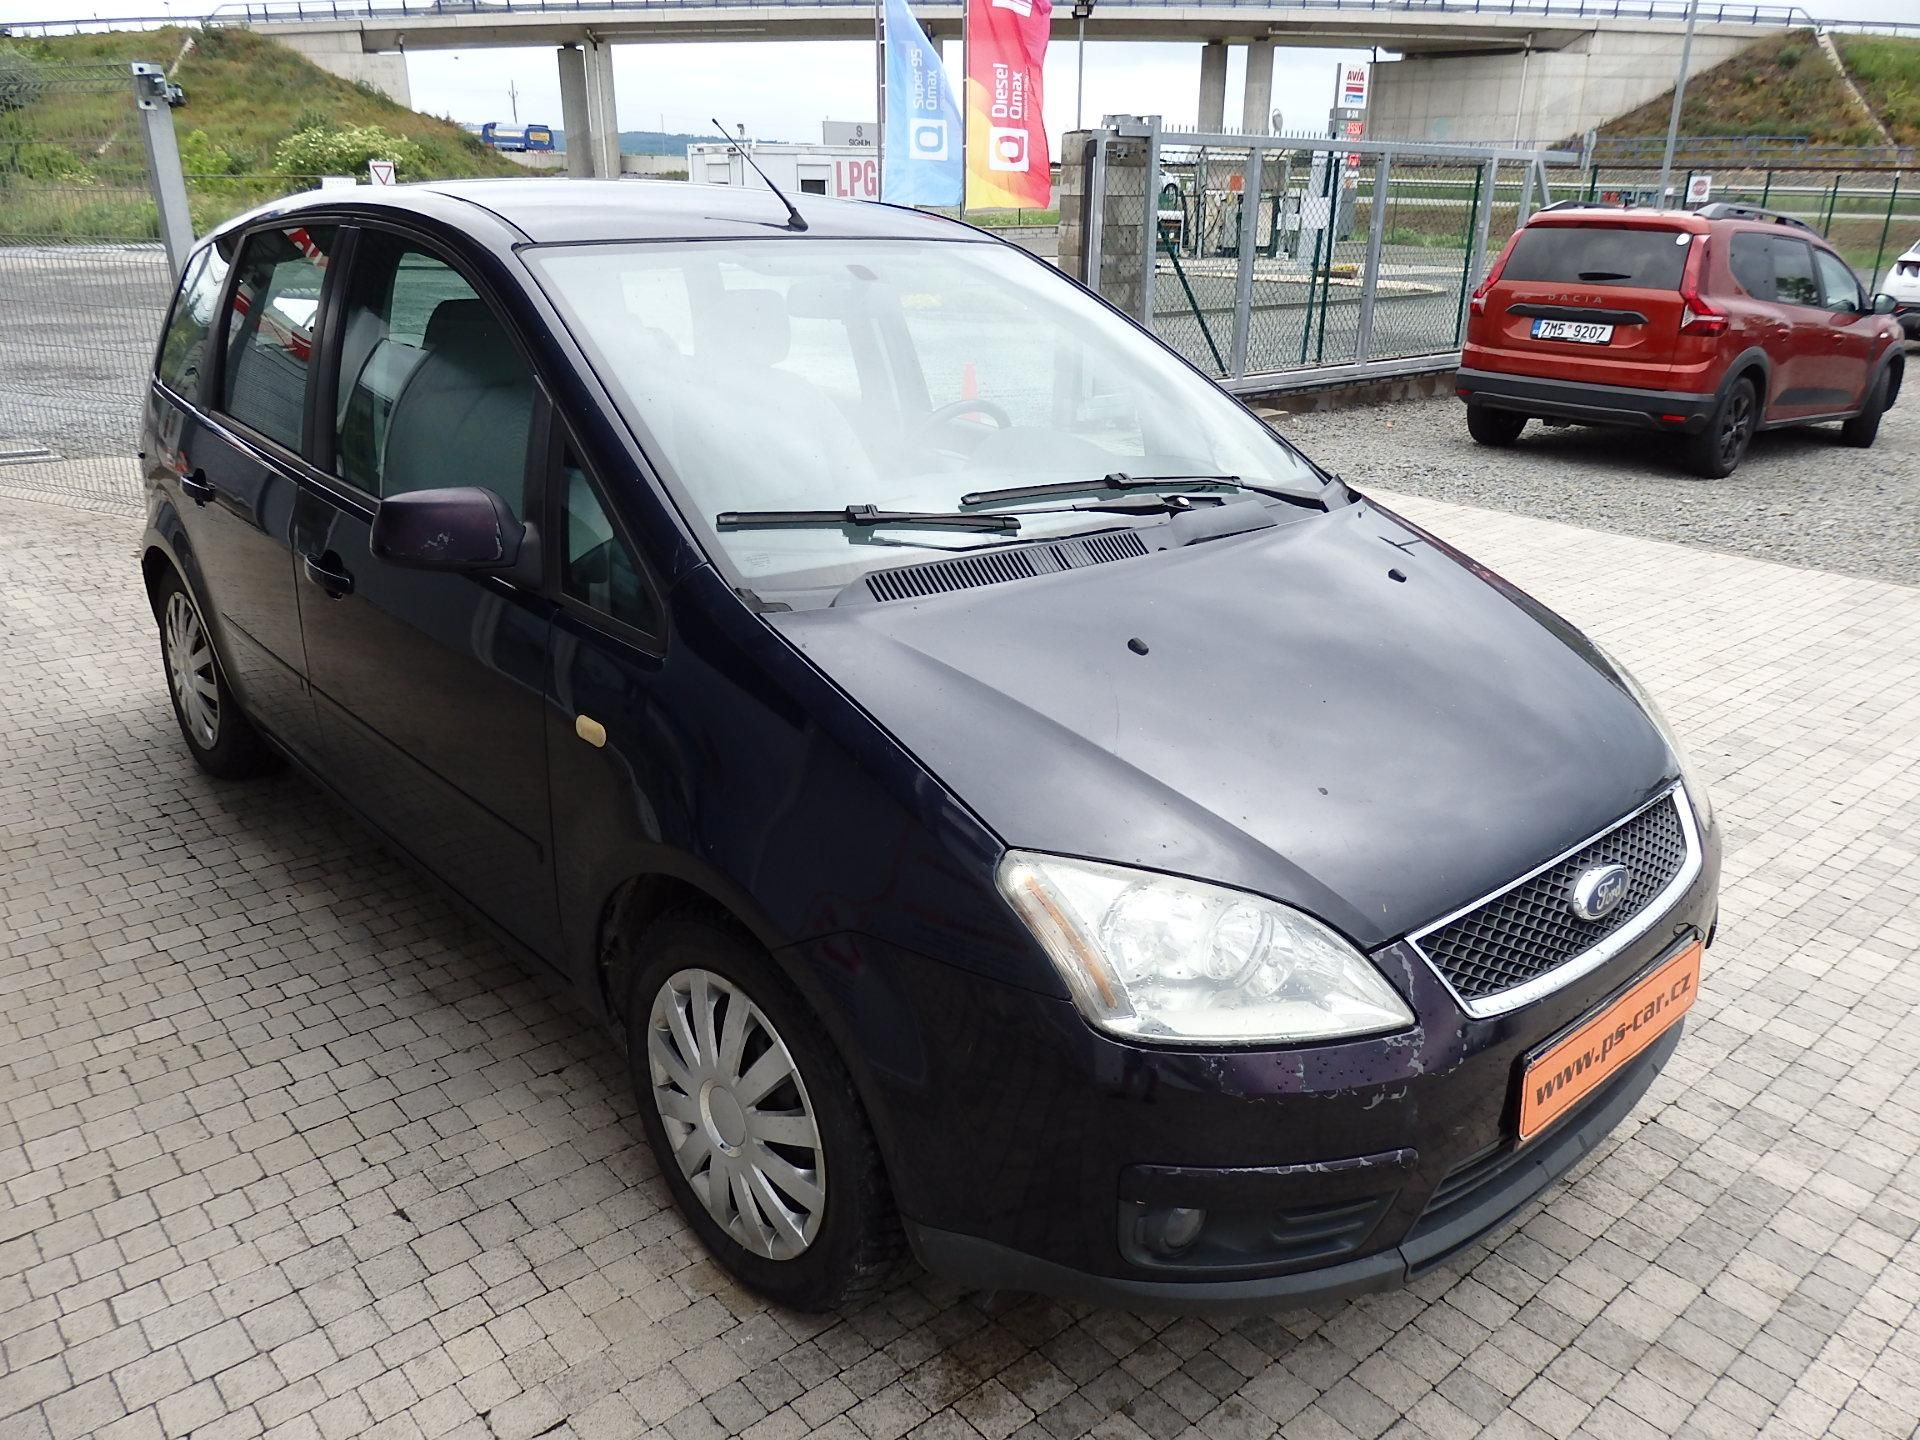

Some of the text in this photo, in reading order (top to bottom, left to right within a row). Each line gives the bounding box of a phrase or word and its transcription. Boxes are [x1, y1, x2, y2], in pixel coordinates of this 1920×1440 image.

[911, 48, 925, 109] Super 95
[925, 69, 938, 111] Qmax
[992, 63, 1008, 118] Diesel
[1009, 71, 1023, 120] Qmax
[848, 138, 871, 147] SIGNUM
[835, 160, 877, 197] LPG
[1548, 294, 1602, 303] DACIA
[1541, 322, 1606, 340] 7M5 9207
[1597, 877, 1622, 910] Ford
[1536, 971, 1692, 1106] www.ps-car.cz
